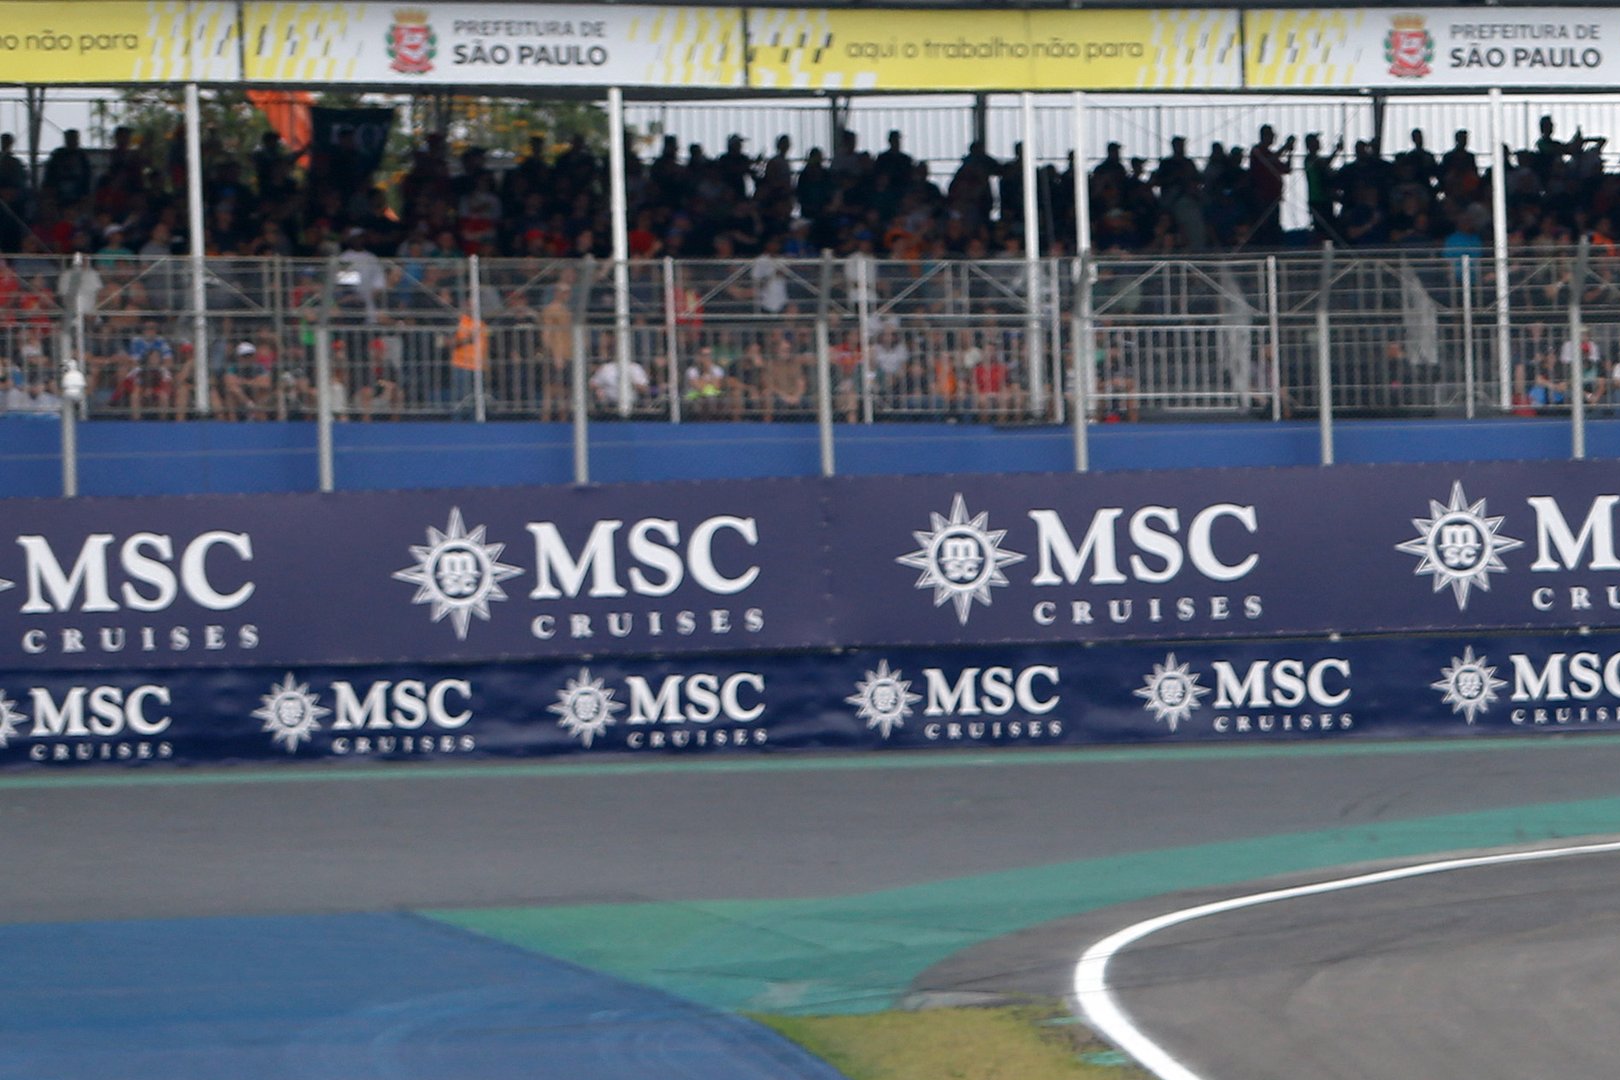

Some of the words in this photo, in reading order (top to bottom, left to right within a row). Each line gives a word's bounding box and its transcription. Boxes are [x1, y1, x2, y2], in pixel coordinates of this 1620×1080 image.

[26, 30, 72, 50] não
[80, 34, 138, 55] para
[454, 20, 574, 36] PREFEITURA
[580, 21, 606, 37] DE
[1451, 24, 1570, 39] PREFEITURA
[1575, 25, 1601, 39] DE
[453, 38, 510, 65] SÃO
[518, 44, 608, 66] PAULO
[846, 37, 898, 62] aqui
[903, 42, 919, 58] o
[924, 37, 1029, 58] trabalho
[1033, 38, 1081, 58] não
[1087, 42, 1144, 62] para
[1451, 43, 1504, 68] SÃO
[1514, 47, 1602, 68] PAULO
[526, 515, 760, 599] MSC
[1027, 503, 1259, 585] MSC
[16, 531, 254, 613] MSC
[531, 608, 764, 639] CRUISES
[1033, 595, 1262, 625] CRUISES
[22, 624, 259, 654] CRUISES
[923, 665, 1060, 716] MSC
[1212, 658, 1351, 709] MSC
[30, 685, 170, 737] MSC
[330, 679, 472, 730] MSC
[623, 672, 765, 725] MSC
[627, 728, 768, 747] CRUISES
[924, 720, 1062, 739] CRUISES
[1212, 713, 1352, 733] CRUISES
[30, 742, 172, 761] CRUISES
[332, 734, 475, 754] CRUISES
